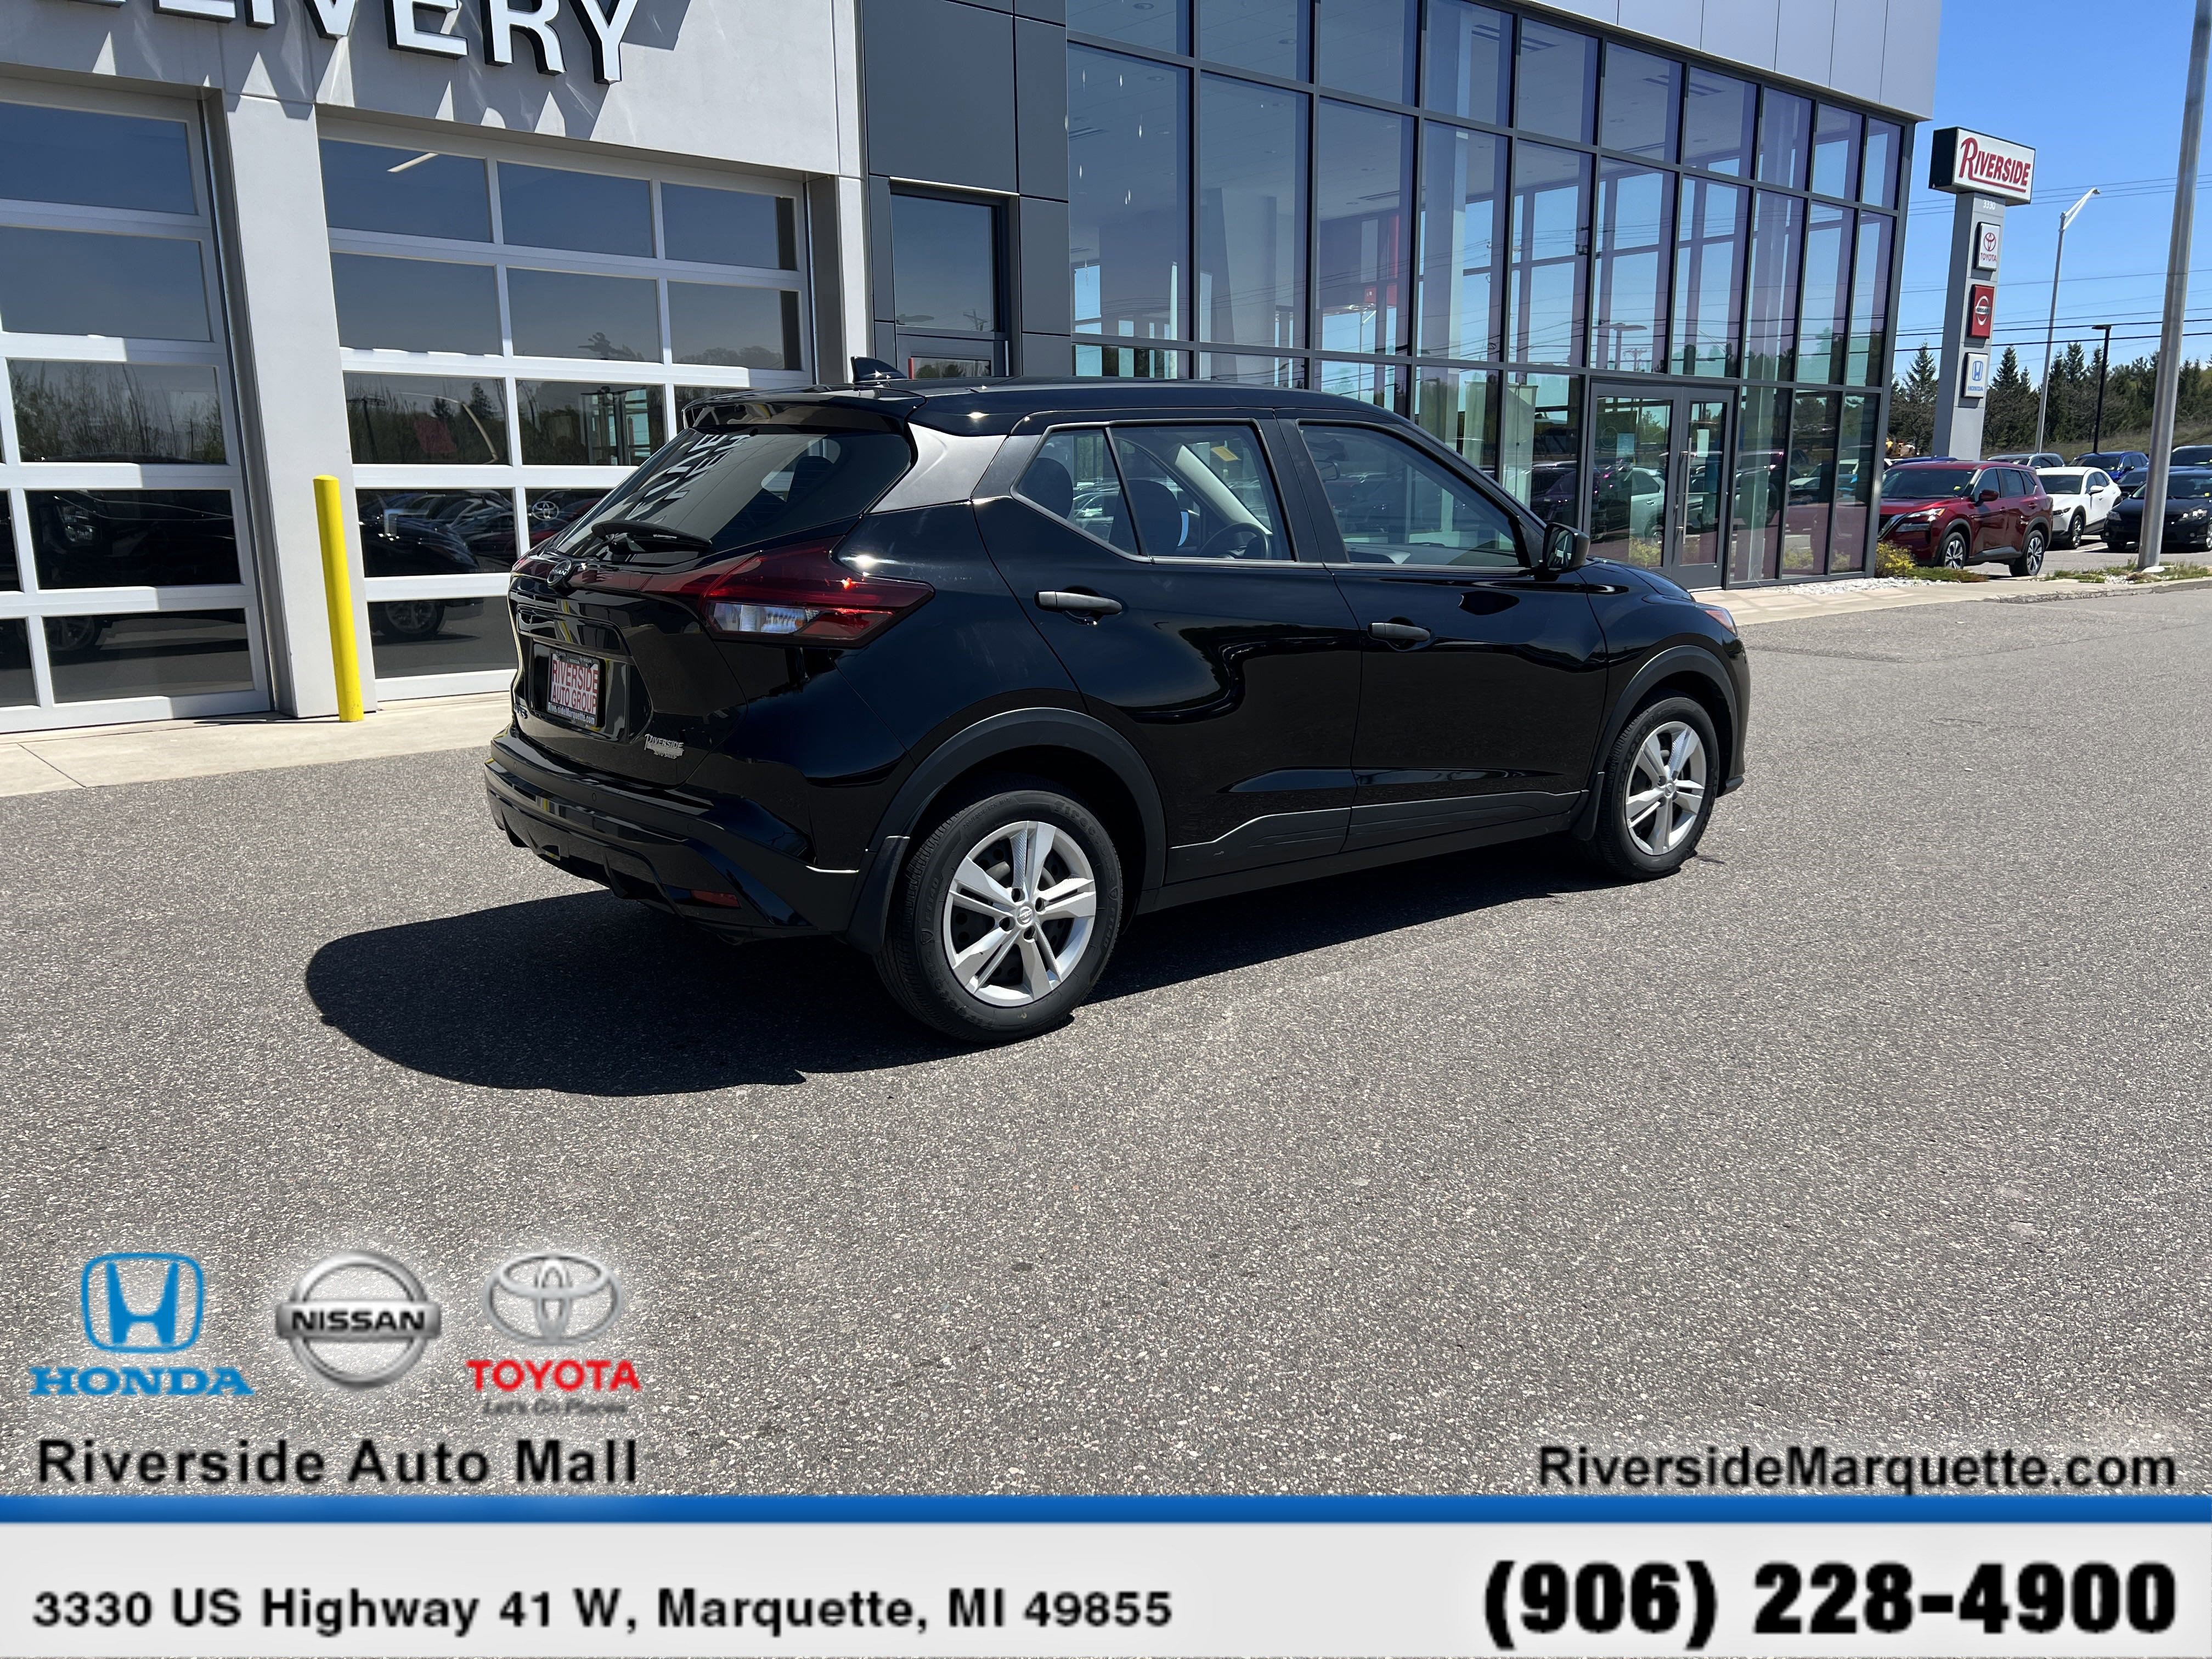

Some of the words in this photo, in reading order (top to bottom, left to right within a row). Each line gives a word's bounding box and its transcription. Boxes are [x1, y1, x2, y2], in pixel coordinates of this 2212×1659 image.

[1959, 137, 2031, 190] RIVERSIDE
[1983, 199, 1996, 210] 3330
[1980, 252, 1997, 262] TOYOTA
[552, 660, 599, 694] RIVERSIDE
[552, 685, 570, 706] AUTO
[571, 689, 597, 713] GROUP
[644, 733, 684, 751] RIVERSIDE
